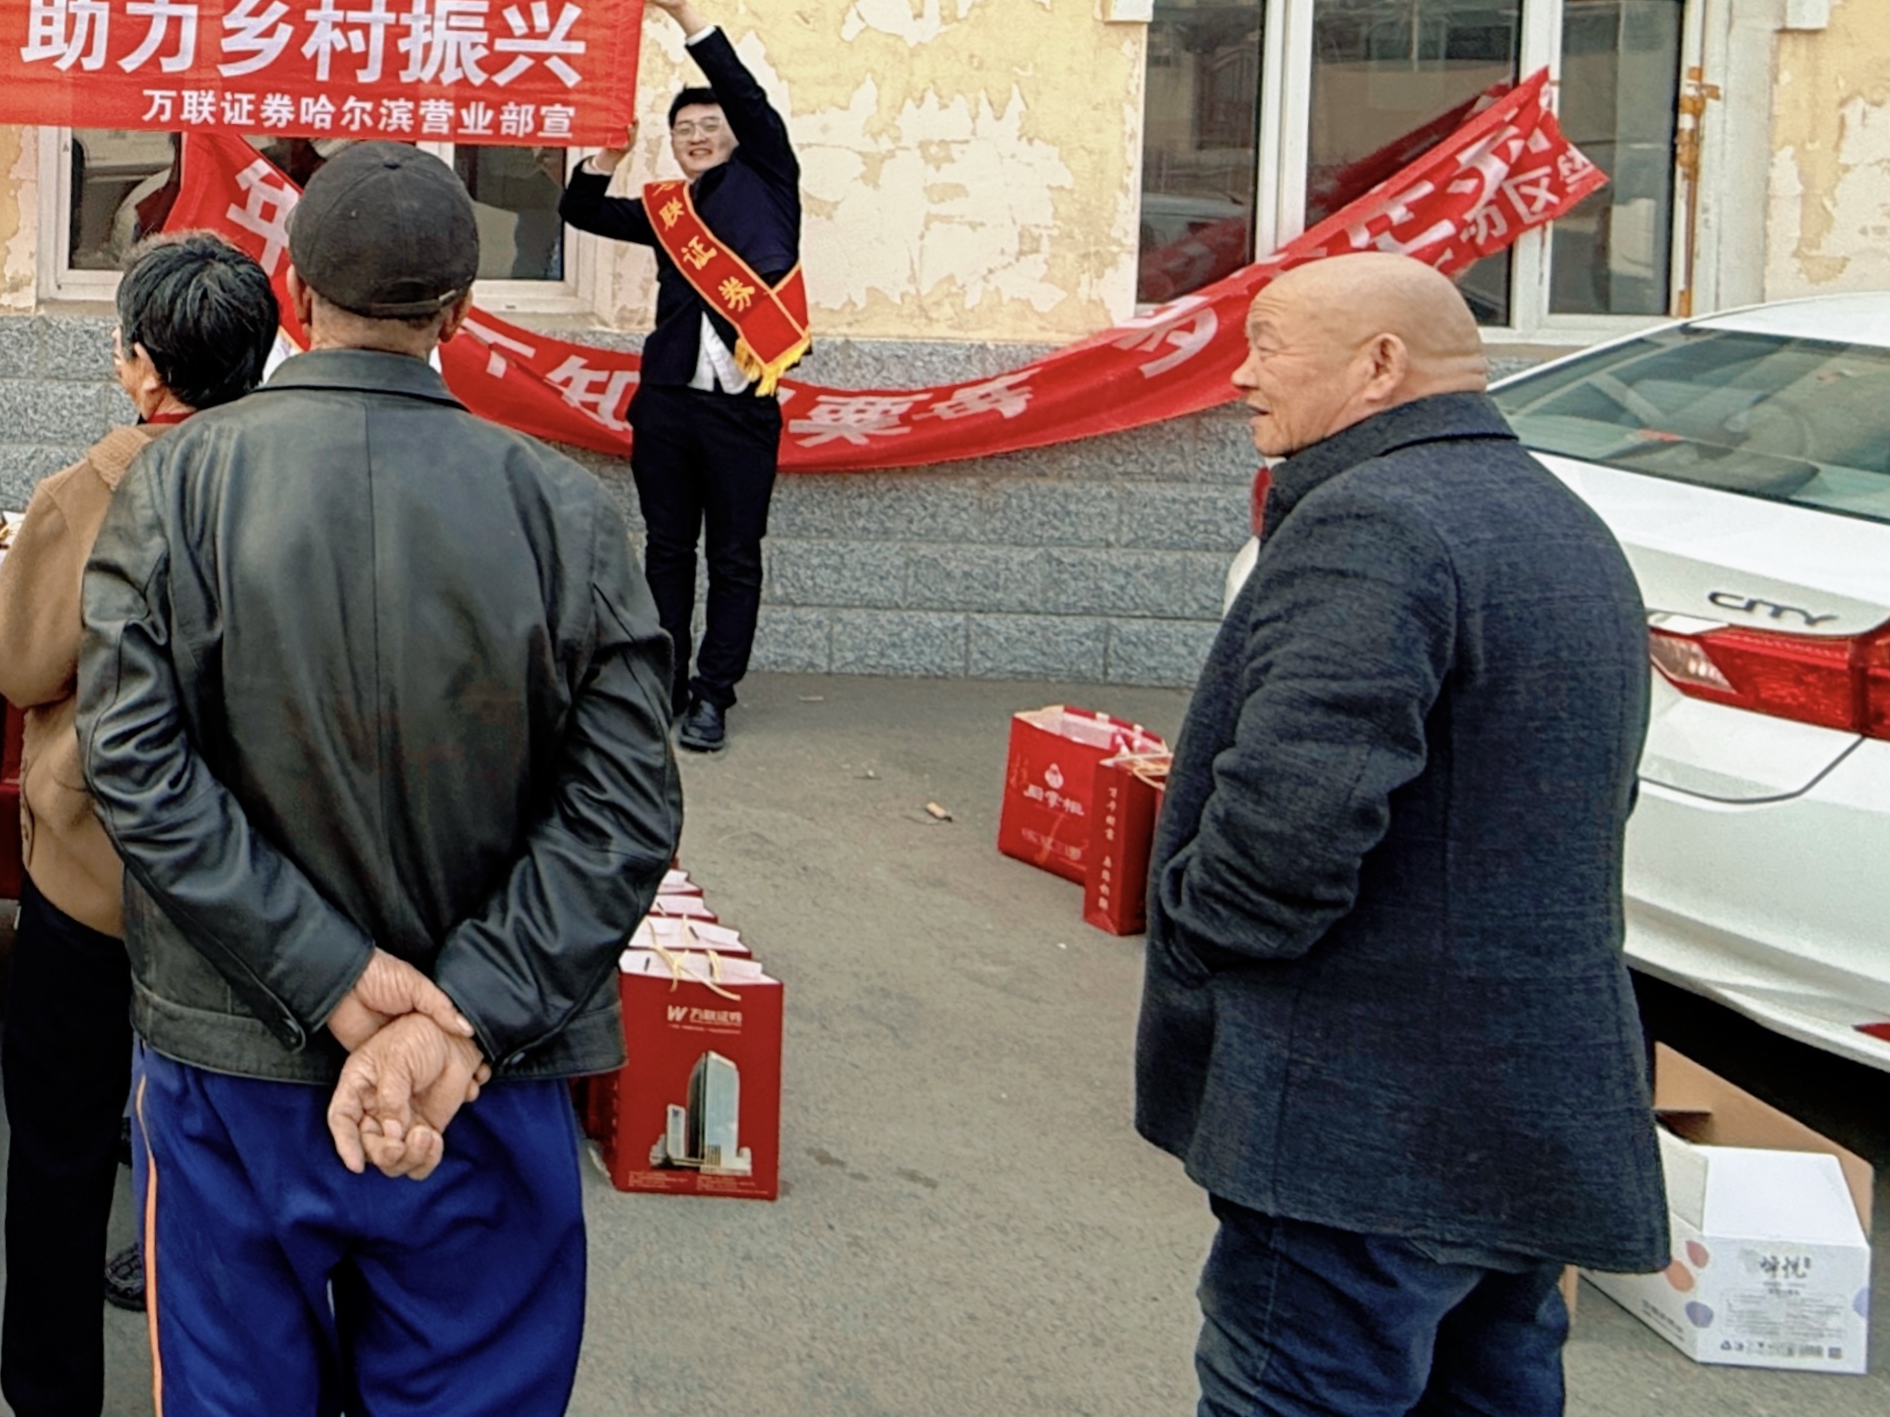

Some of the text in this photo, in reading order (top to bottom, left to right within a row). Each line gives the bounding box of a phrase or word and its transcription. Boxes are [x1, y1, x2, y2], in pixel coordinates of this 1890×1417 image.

[141, 88, 576, 139] 万联证券哈尔滨营业部宣
[1708, 590, 1839, 627] CITY
